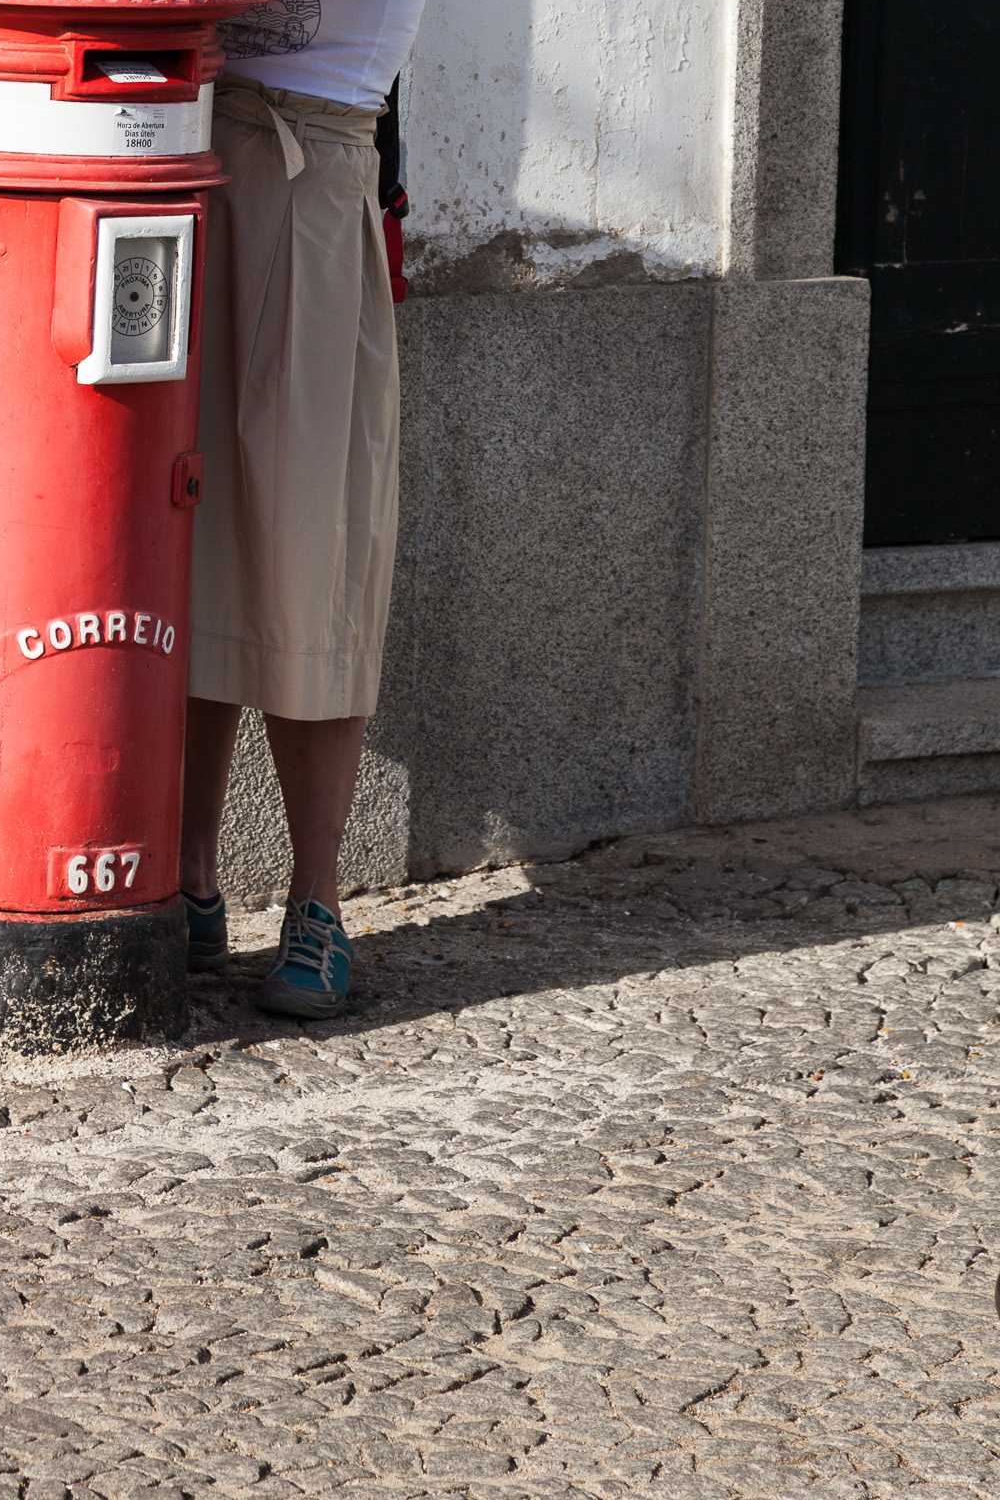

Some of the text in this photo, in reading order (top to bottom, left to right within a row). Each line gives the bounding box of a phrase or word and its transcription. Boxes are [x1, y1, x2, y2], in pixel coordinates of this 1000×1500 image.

[126, 139, 152, 147] 18H00
[118, 303, 150, 317] ABERTURA
[17, 612, 175, 660] CORREIO
[68, 852, 140, 894] 667
